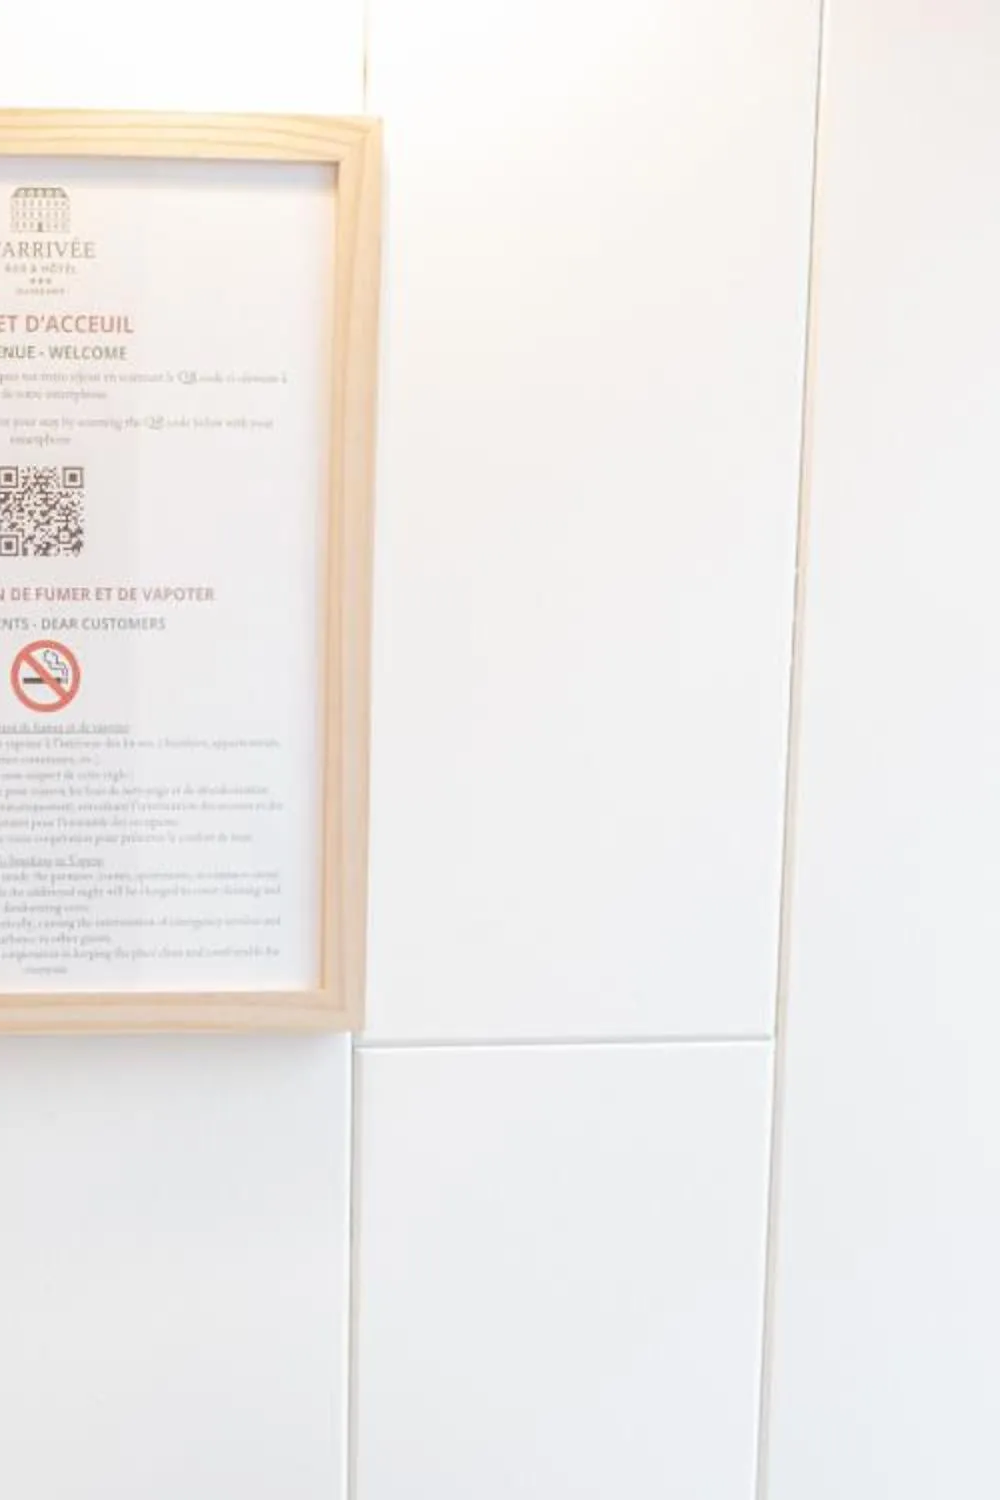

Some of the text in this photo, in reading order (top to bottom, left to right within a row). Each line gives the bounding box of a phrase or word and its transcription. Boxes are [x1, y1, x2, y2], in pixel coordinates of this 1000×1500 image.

[25, 314, 135, 334] D'ACCEUIL
[48, 344, 128, 360] WELCOME
[11, 586, 32, 602] DE
[35, 586, 91, 602] FUMER
[95, 586, 114, 602] ET
[118, 586, 138, 602] DE
[143, 586, 215, 602] VAPOTER
[41, 617, 79, 631] DEAR
[82, 617, 166, 631] CUSTOMERS
